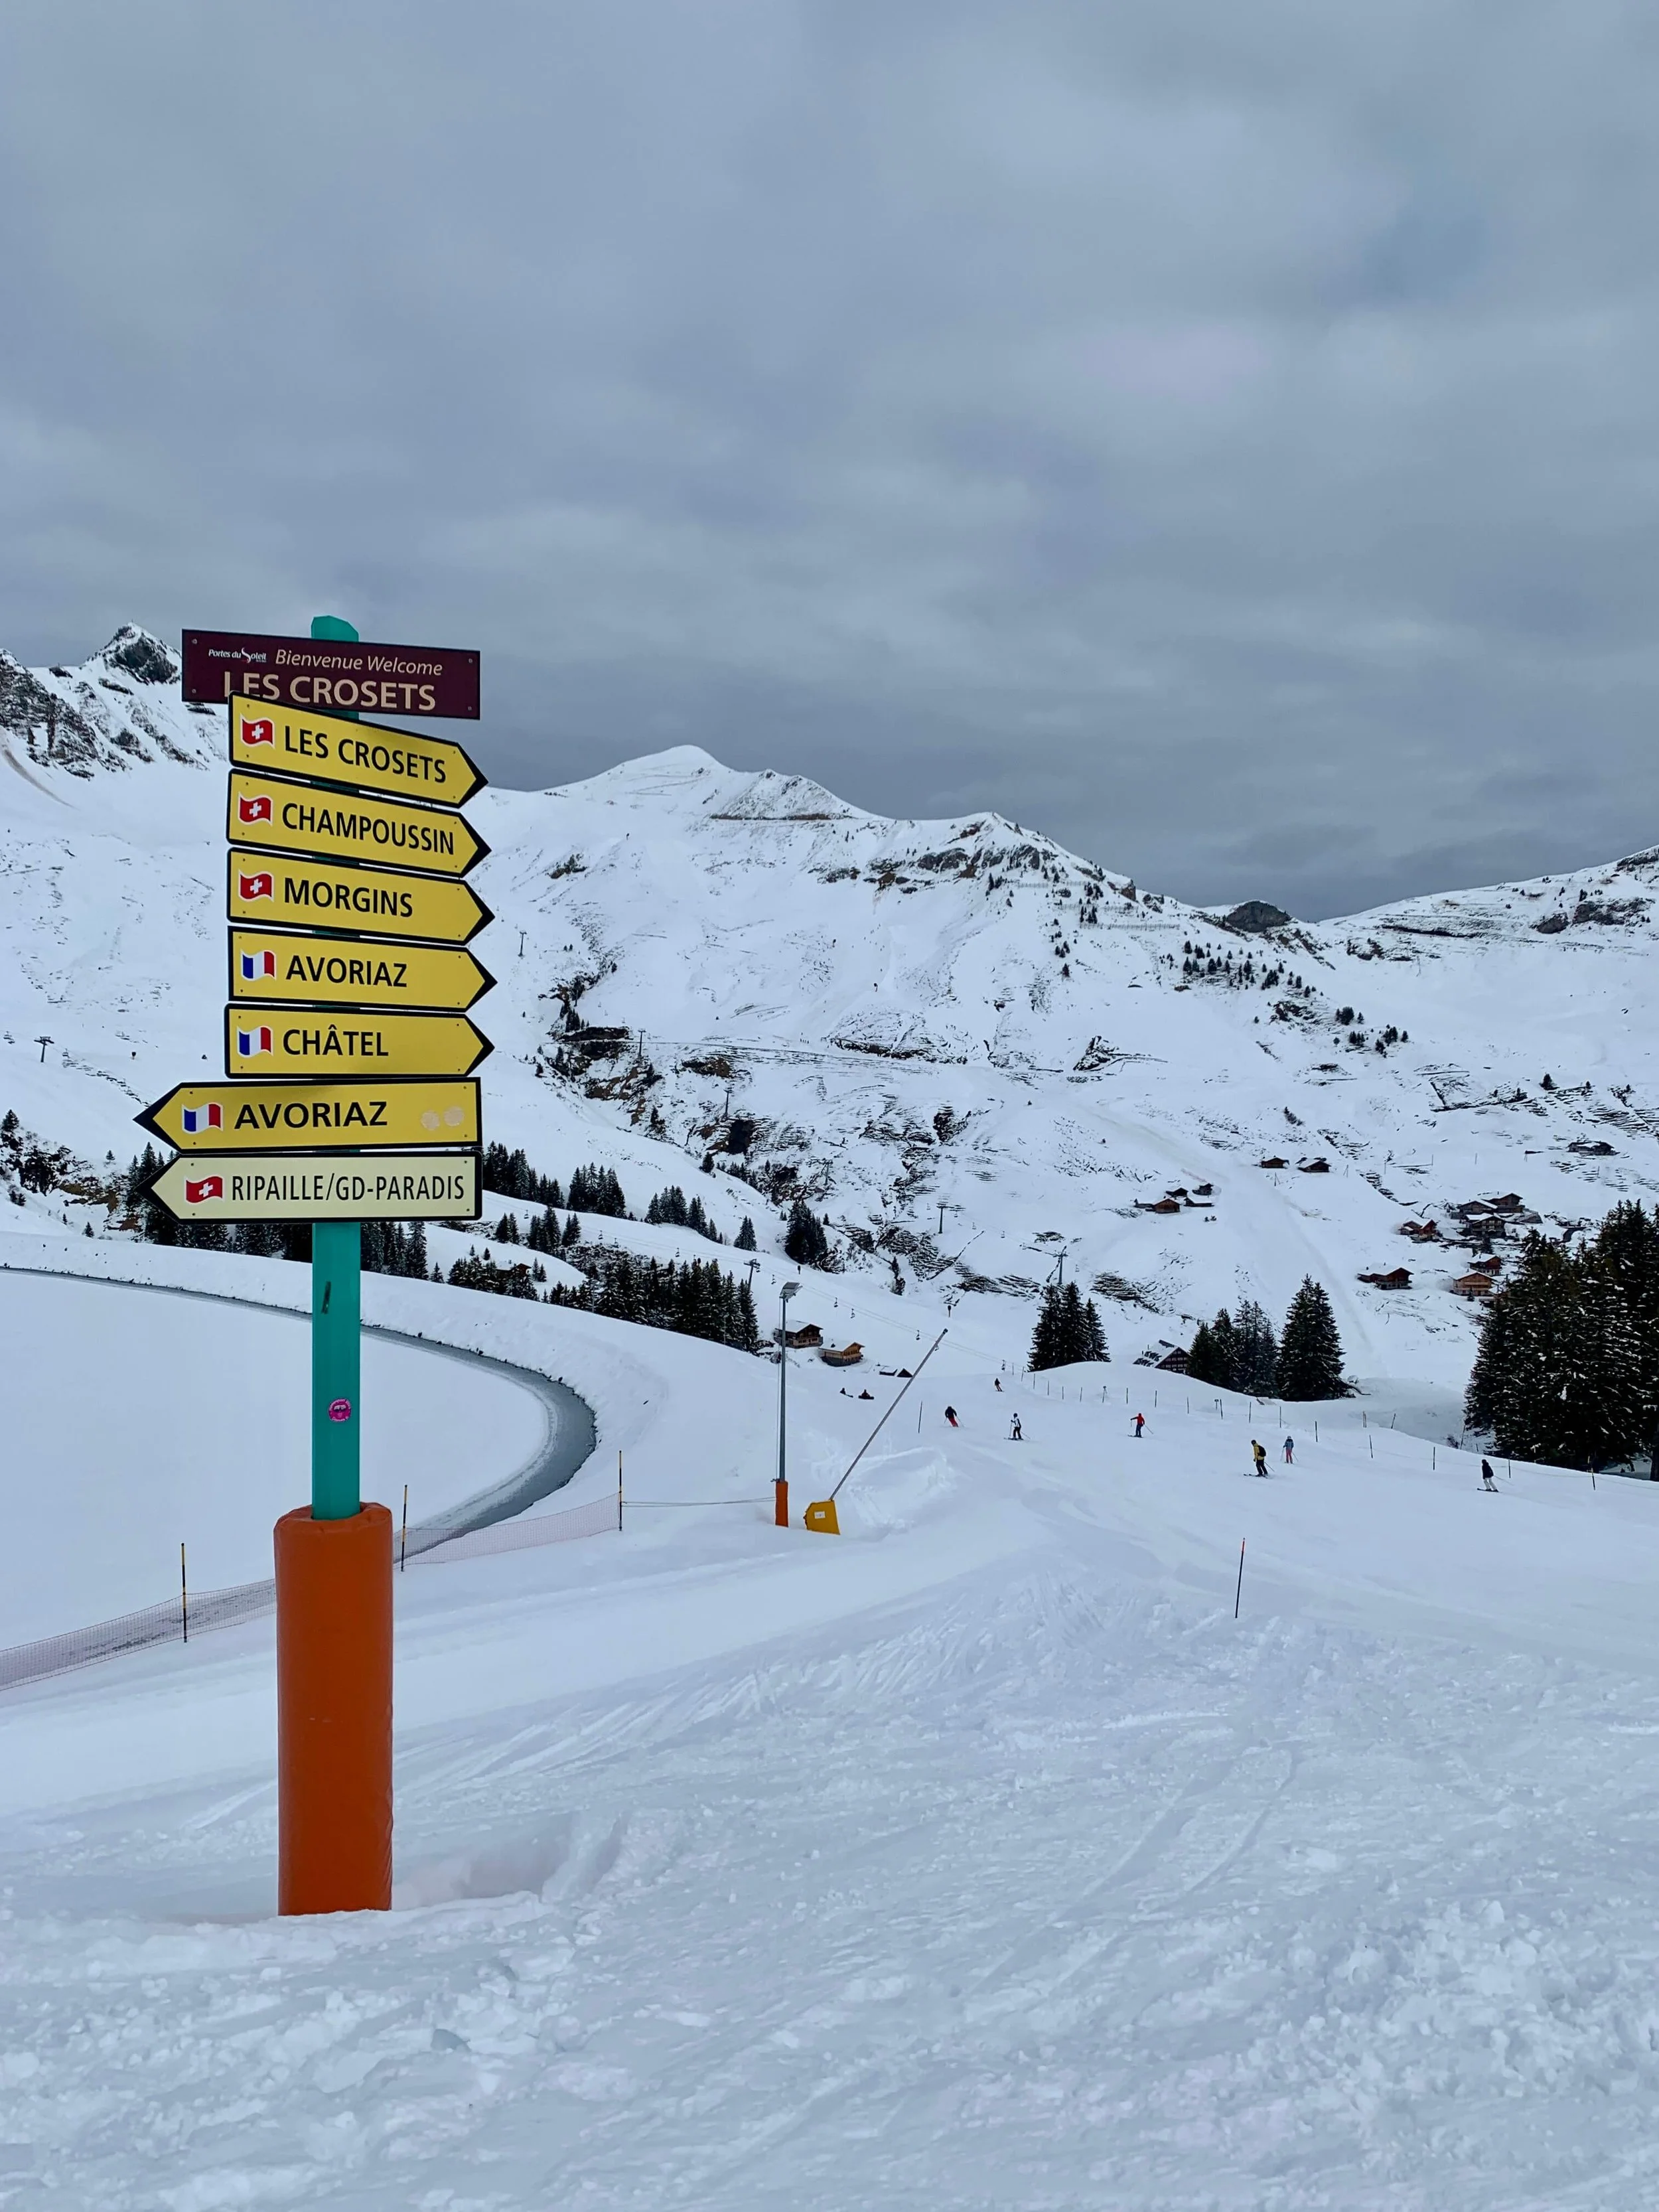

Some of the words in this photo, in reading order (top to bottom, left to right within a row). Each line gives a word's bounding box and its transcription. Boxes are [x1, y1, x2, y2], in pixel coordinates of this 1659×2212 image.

[208, 648, 230, 658] Portes
[232, 650, 242, 658] du
[241, 647, 267, 663] Soleil
[275, 649, 363, 670] Bienvenue
[368, 656, 443, 676] Welcome
[290, 676, 436, 711] CROSETS
[285, 725, 328, 759] LES
[338, 739, 446, 783] CROSETS
[282, 802, 454, 855] CHAMPOUSSIN
[284, 877, 413, 918] MORGINS
[285, 955, 407, 988] AVORIAZ
[283, 1024, 389, 1057] CHÂTEL
[234, 1101, 388, 1130] AVORIAZ
[232, 1172, 465, 1201] RIPAILLE/GD-PARADIS
